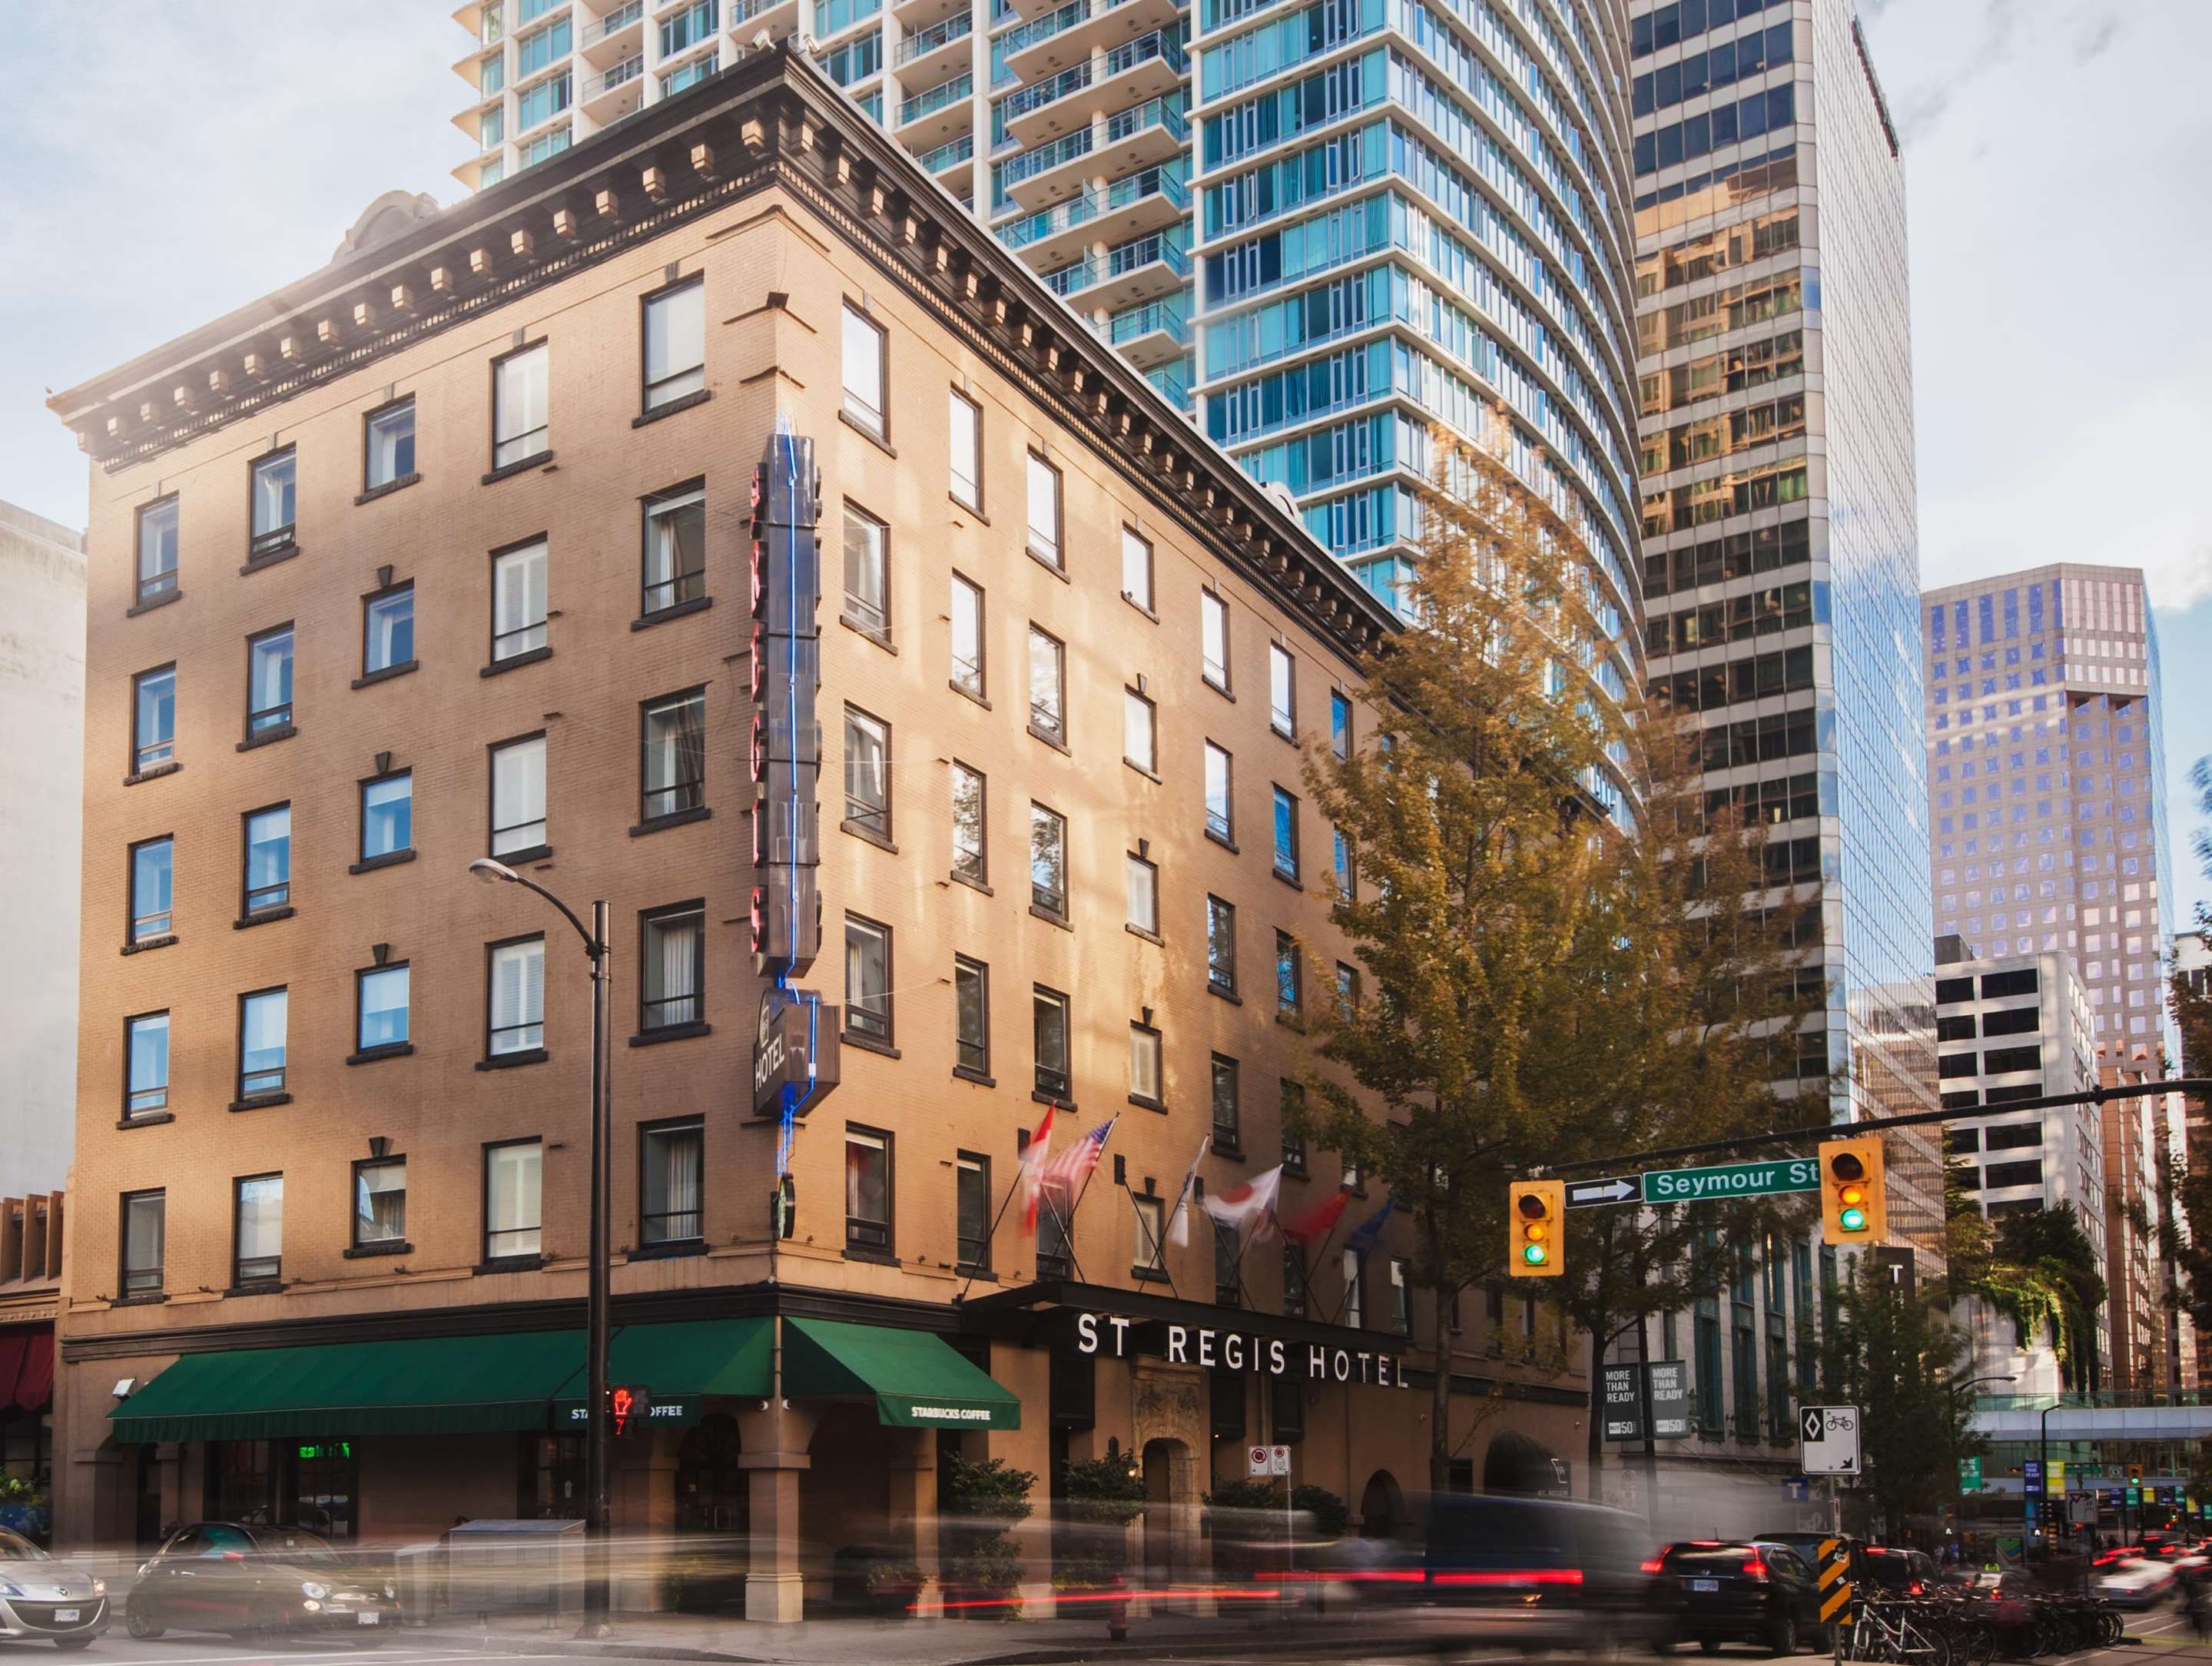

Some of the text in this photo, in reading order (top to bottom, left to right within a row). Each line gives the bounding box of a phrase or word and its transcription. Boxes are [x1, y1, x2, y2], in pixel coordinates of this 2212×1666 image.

[754, 1033, 785, 1092] HOTEL
[1657, 1163, 1819, 1196] Seymour St
[1078, 1313, 1409, 1389] ST REGIS HOTEL
[1605, 1370, 1631, 1381] MORE
[1652, 1367, 1679, 1379] MORE
[1606, 1382, 1629, 1392] THAN
[1653, 1379, 1677, 1389] THAN
[1607, 1392, 1635, 1402] READY
[1653, 1389, 1683, 1400] READY
[911, 1406, 990, 1420] STARBUCKS COFFEE
[1787, 1482, 1802, 1498] T
